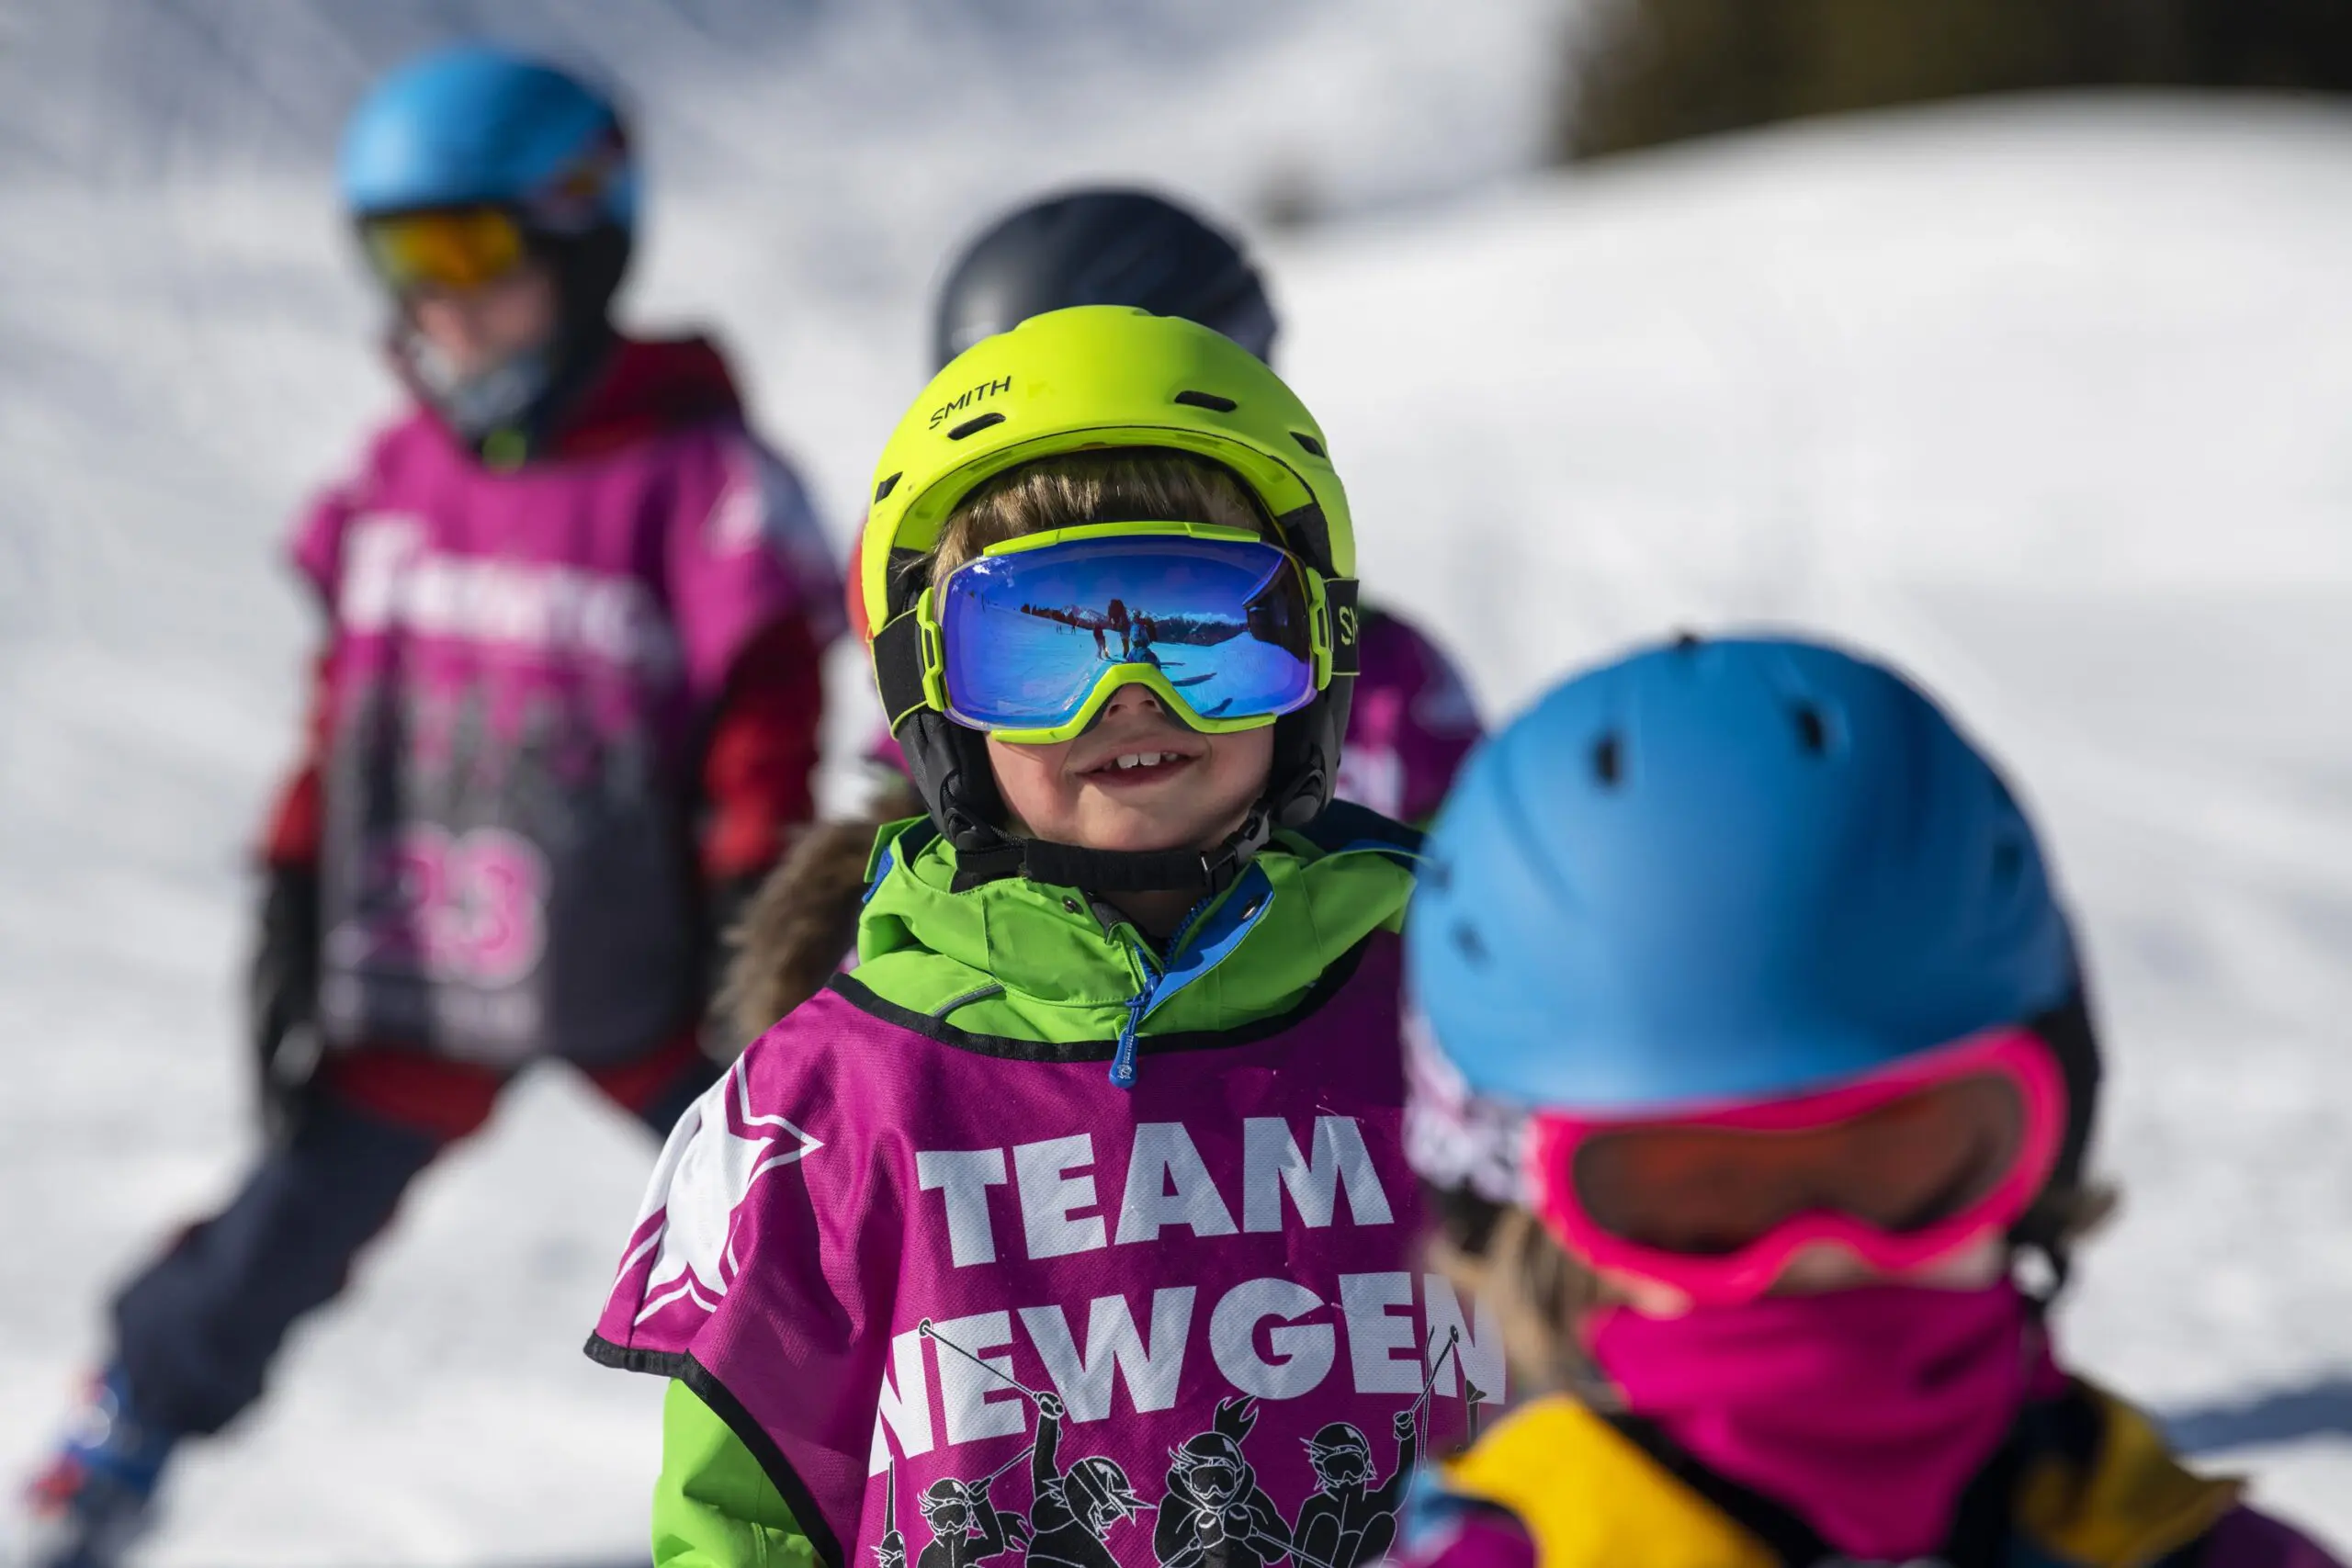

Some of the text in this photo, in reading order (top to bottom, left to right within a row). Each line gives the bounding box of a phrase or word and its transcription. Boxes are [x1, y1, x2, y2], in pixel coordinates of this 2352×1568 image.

[929, 375, 1012, 430] SMITH
[916, 1116, 1394, 1268] TEAM
[869, 1271, 1507, 1476] NEWGEN
